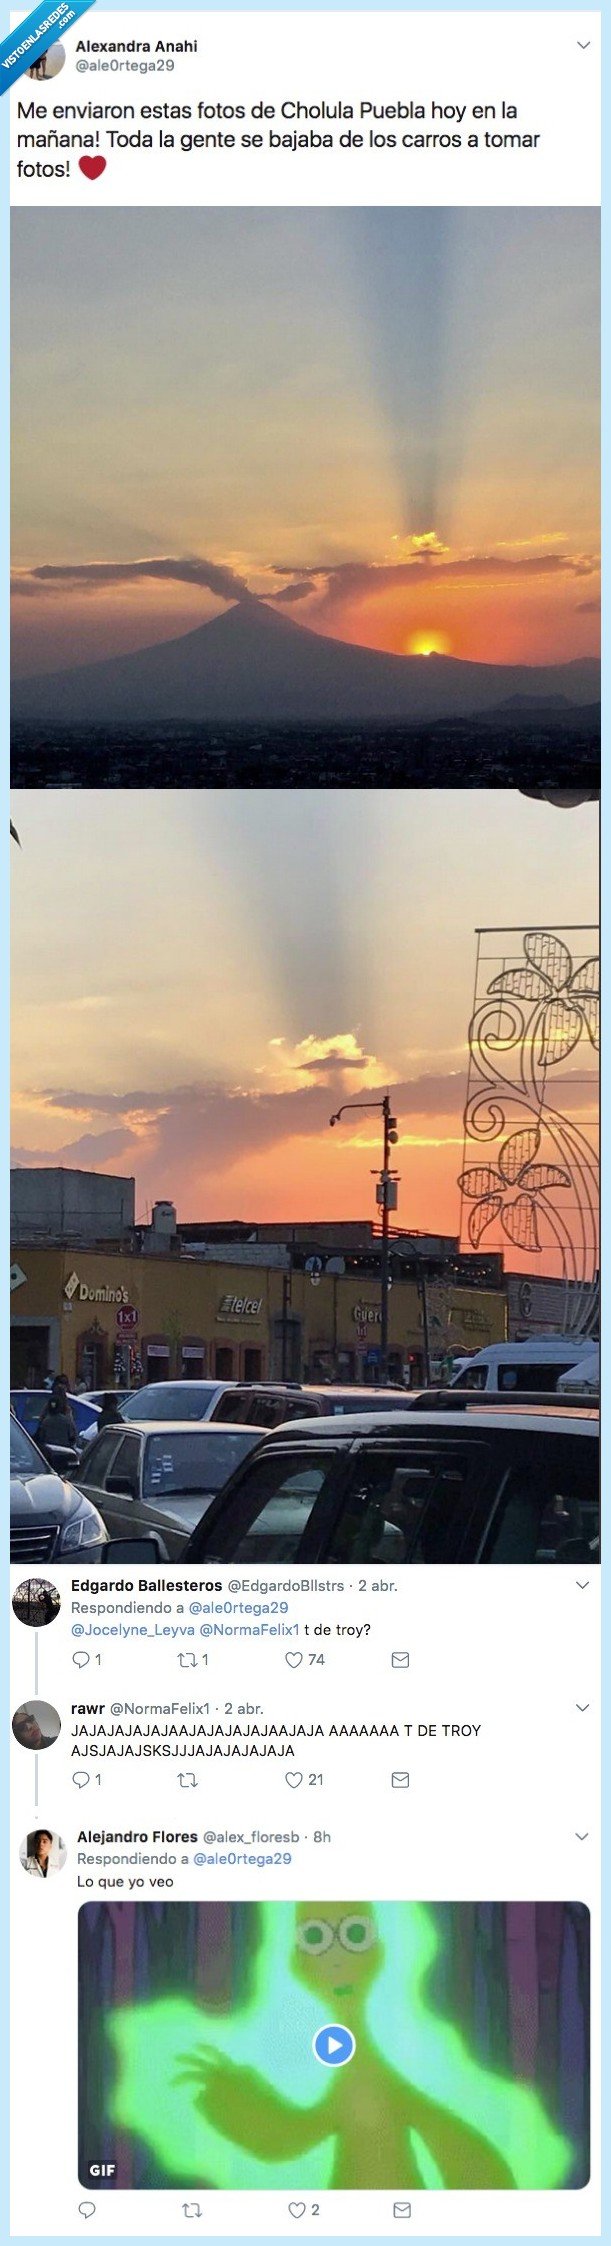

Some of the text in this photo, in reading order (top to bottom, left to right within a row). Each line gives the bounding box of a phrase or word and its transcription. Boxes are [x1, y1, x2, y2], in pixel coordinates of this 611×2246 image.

[80, 1284, 129, 1304] Domino's
[230, 1296, 263, 1314] telcel
[118, 1310, 137, 1323] 1x1
